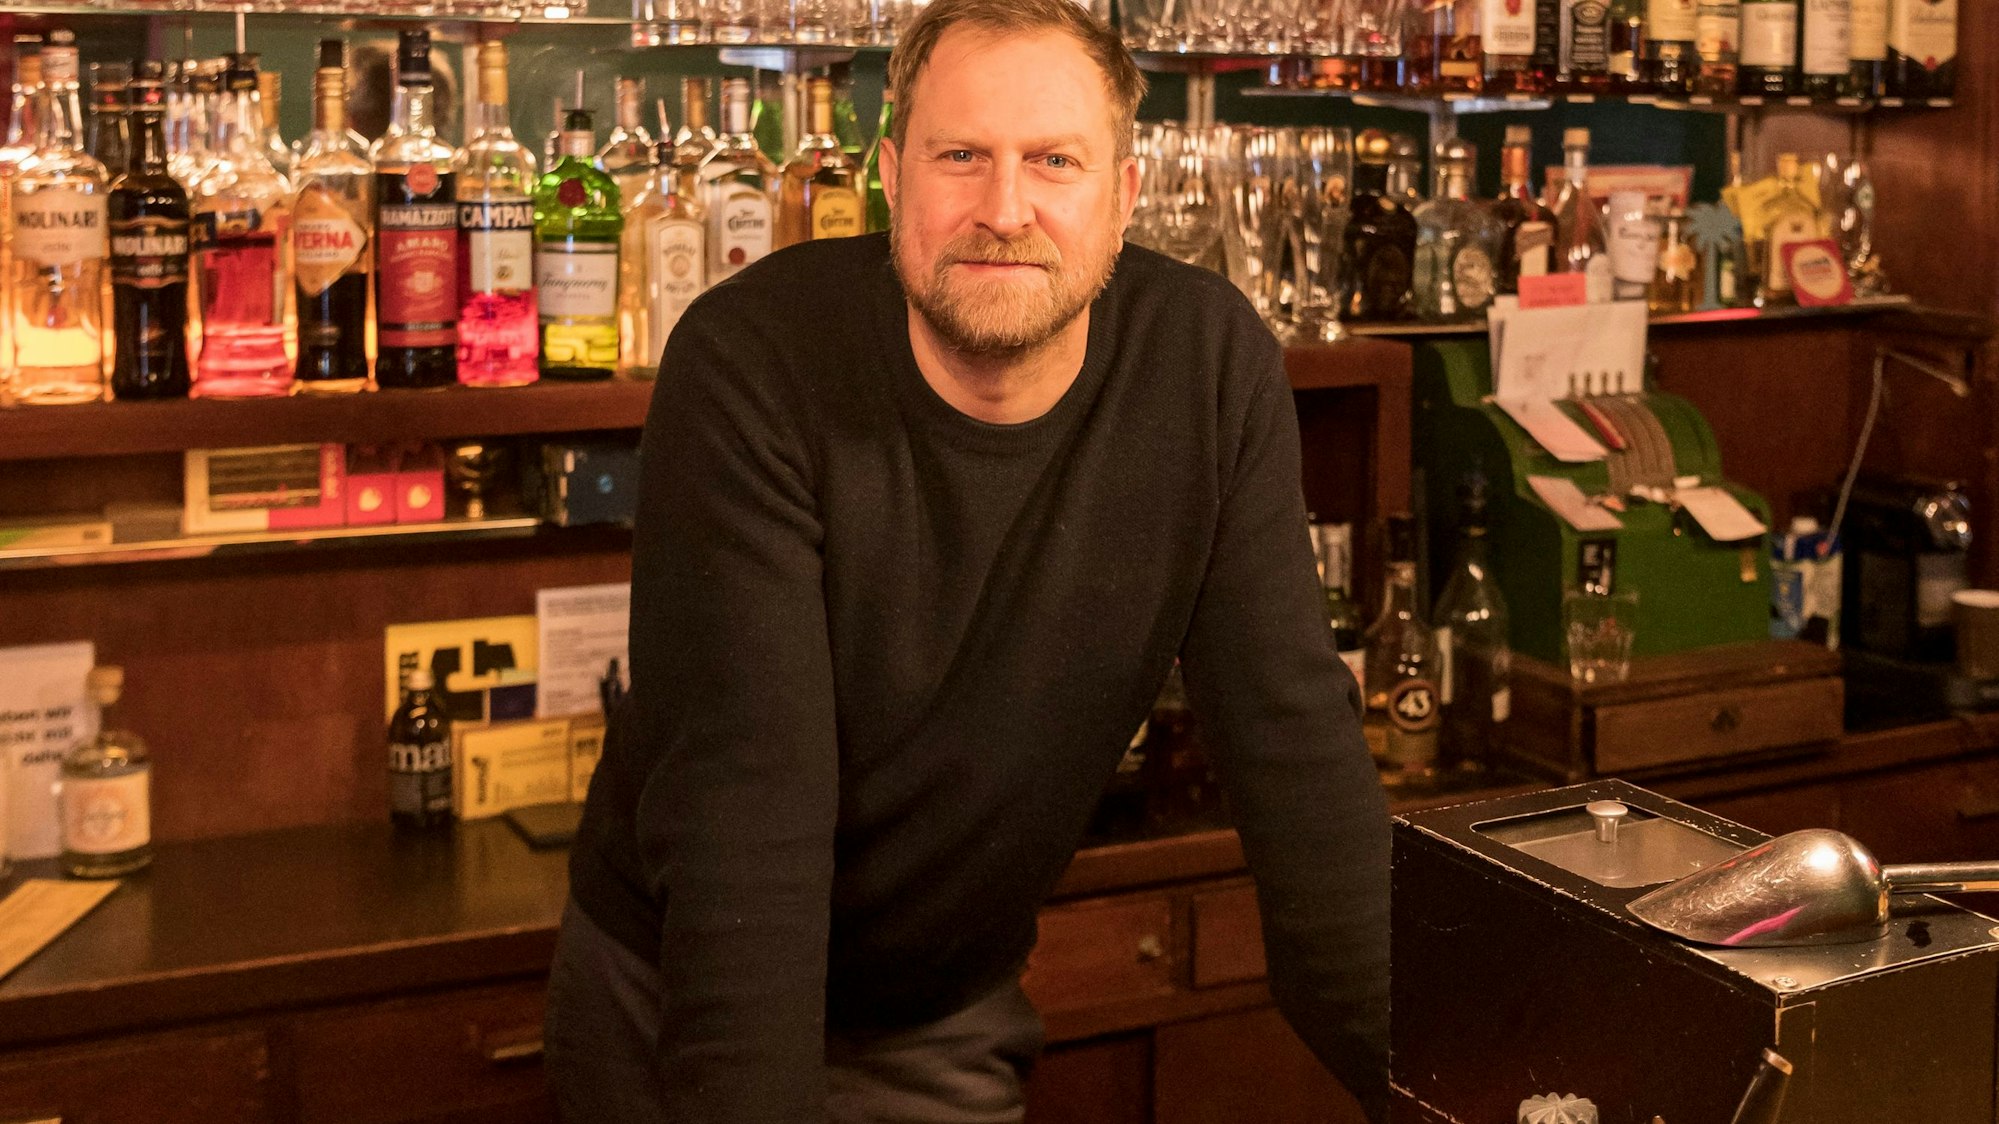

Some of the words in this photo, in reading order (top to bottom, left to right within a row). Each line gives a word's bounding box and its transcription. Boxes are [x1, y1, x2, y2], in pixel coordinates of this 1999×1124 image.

[17, 211, 98, 228] MOLINARI
[112, 235, 188, 256] MOLINAR
[1397, 688, 1432, 718] 43
